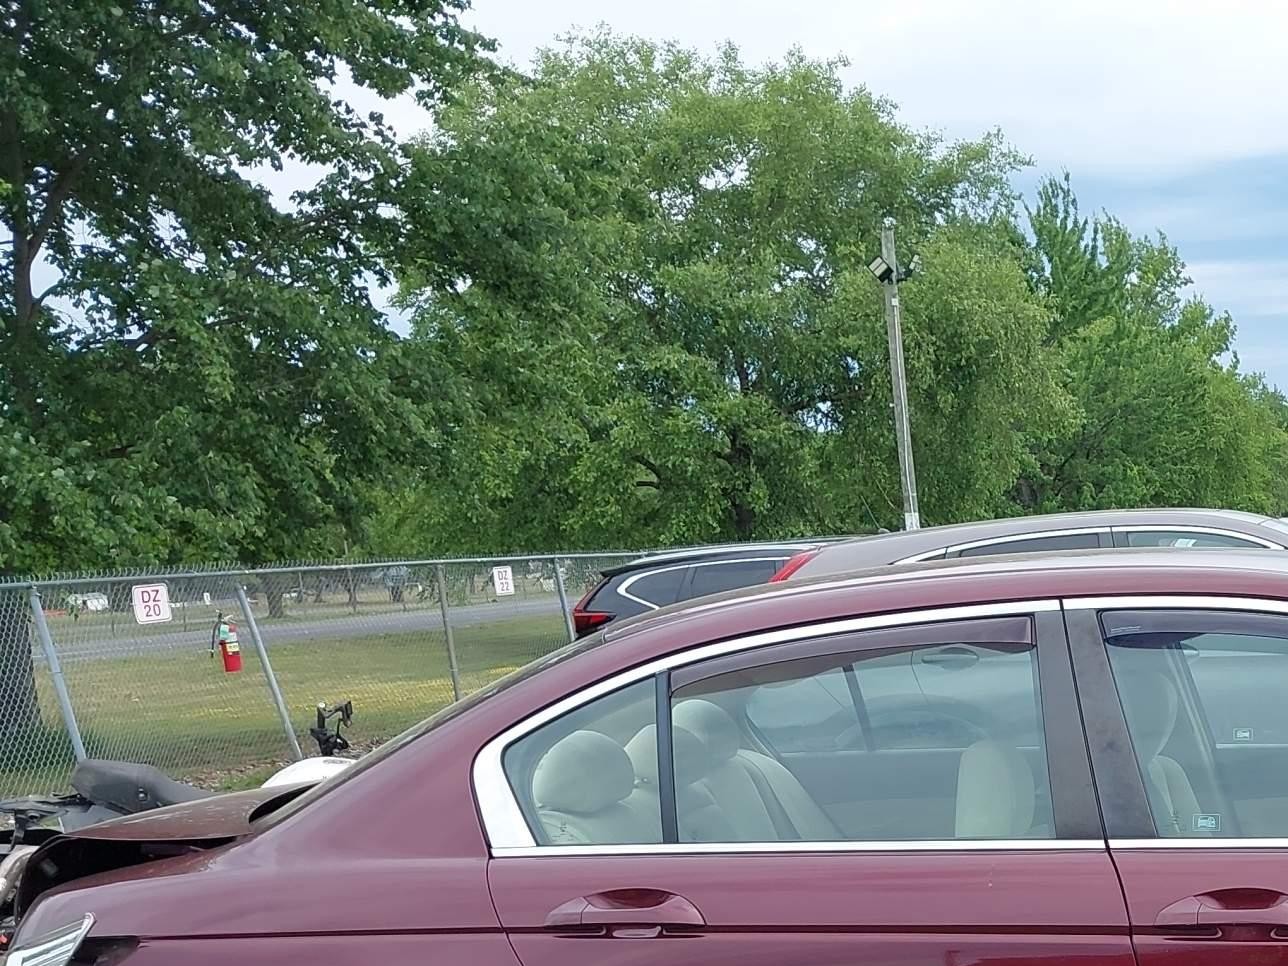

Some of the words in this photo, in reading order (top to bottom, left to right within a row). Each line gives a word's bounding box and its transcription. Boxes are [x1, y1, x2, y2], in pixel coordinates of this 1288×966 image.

[497, 570, 508, 581] DZ
[499, 581, 510, 592] 22
[141, 589, 161, 603] DZ
[143, 603, 161, 617] 20
